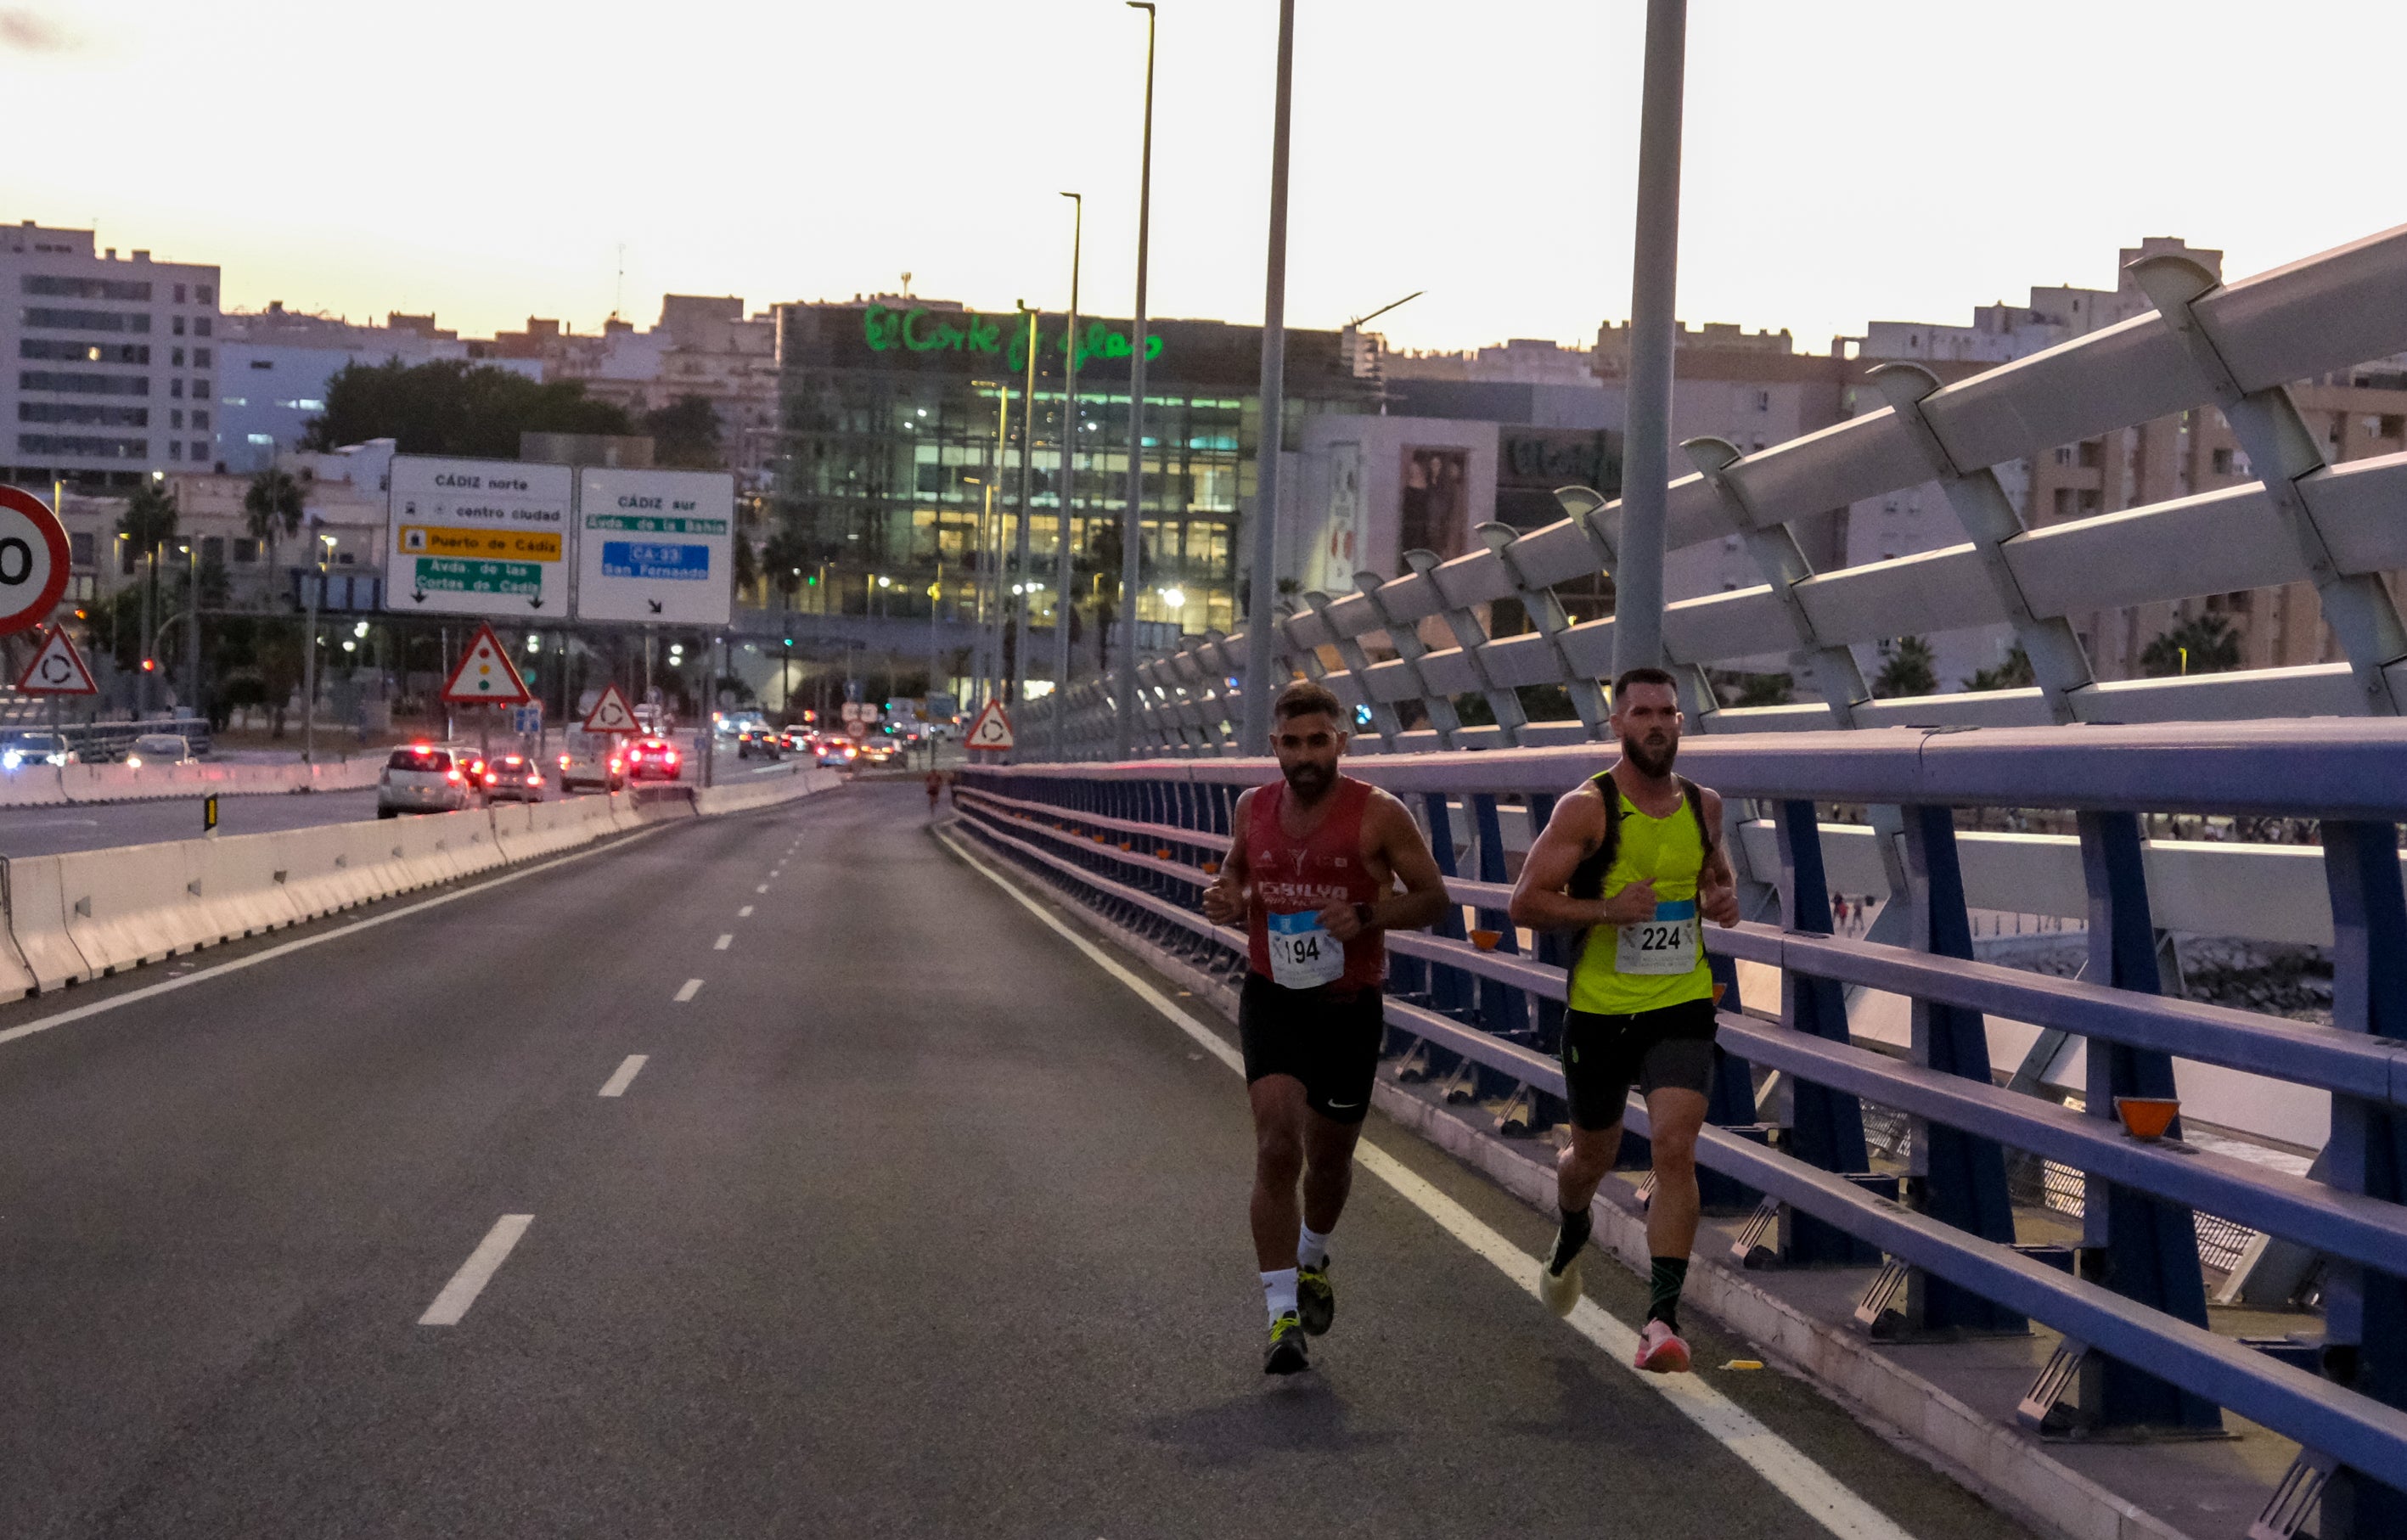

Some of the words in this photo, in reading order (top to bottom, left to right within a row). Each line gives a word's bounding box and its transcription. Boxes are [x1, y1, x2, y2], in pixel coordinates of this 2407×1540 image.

[903, 306, 1000, 353] Corte
[435, 473, 481, 489] CÁDIZ
[488, 477, 528, 491] norte
[618, 493, 664, 509] CÁDIZ
[672, 501, 697, 511] sur
[456, 506, 505, 519] centro
[511, 509, 561, 522] ciudad
[430, 535, 480, 548] Puerto
[488, 538, 506, 550] de
[0, 537, 32, 586] 0
[430, 559, 470, 574] Avda.
[480, 563, 498, 576] de
[506, 564, 528, 577] las
[416, 575, 464, 590] Cortes
[473, 579, 491, 592] de
[1641, 926, 1680, 951] 224
[1285, 936, 1320, 964] 194
